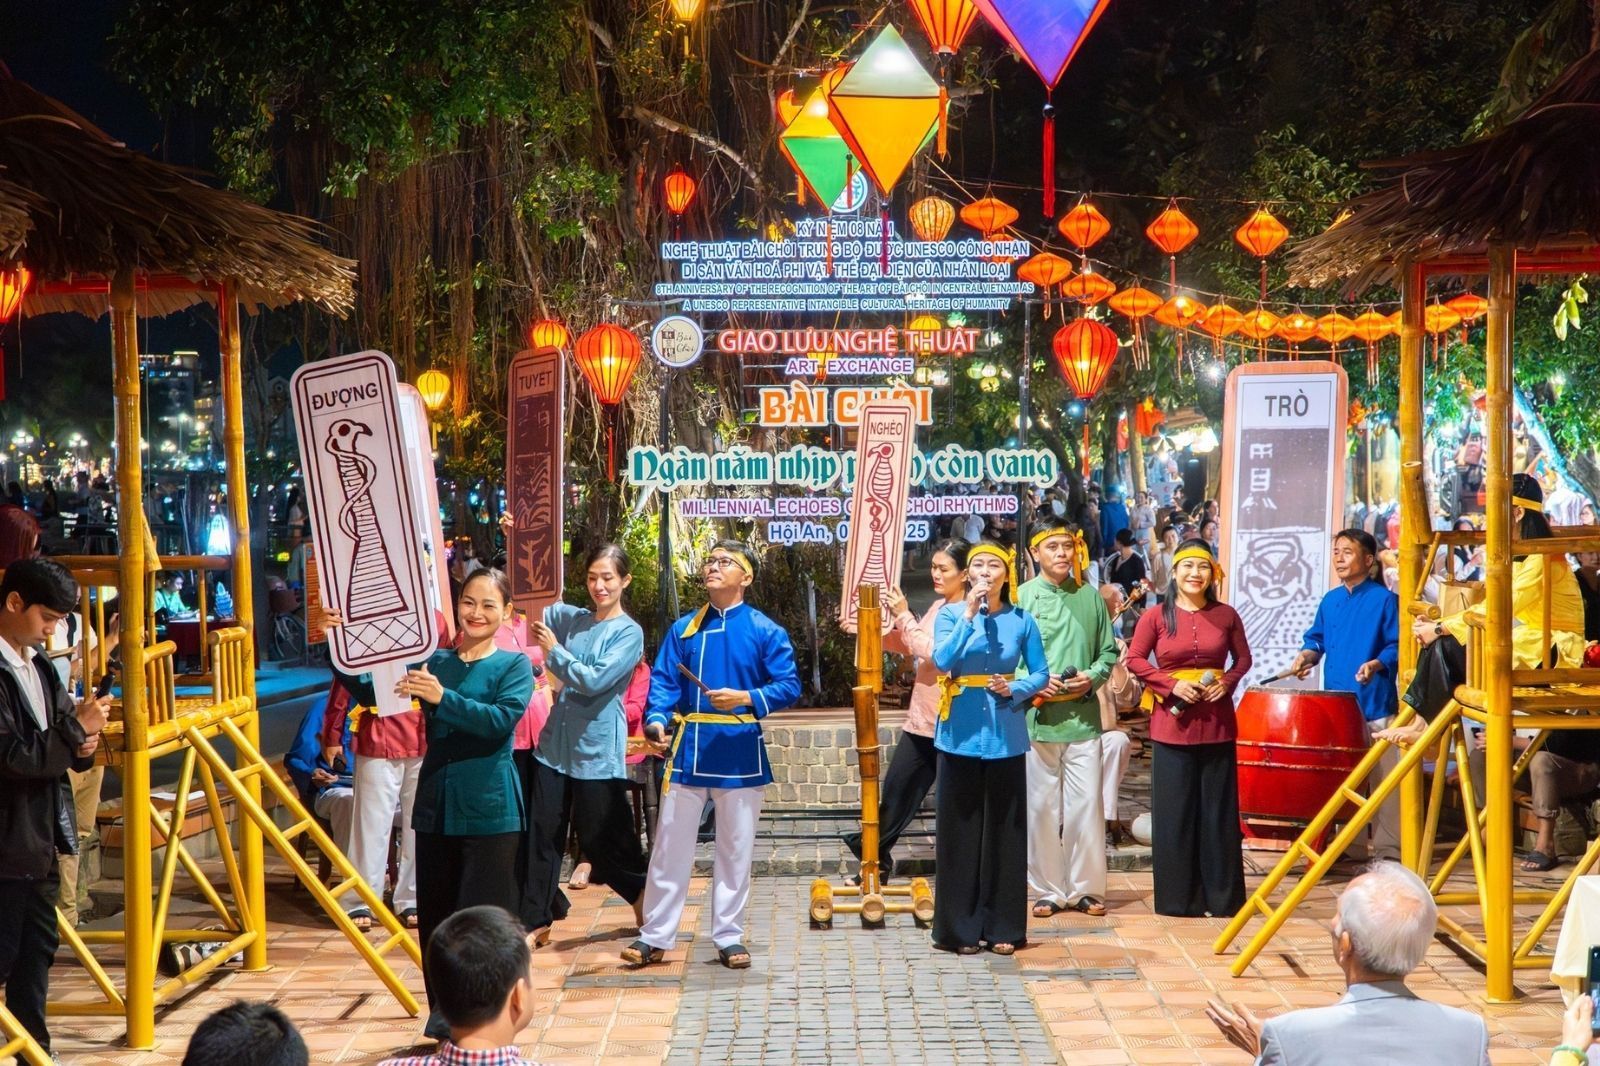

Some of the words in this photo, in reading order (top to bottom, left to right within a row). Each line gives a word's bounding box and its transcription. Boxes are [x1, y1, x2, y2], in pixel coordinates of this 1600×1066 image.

[817, 219, 847, 239] NỆM
[850, 221, 864, 236] 08
[664, 242, 698, 260] NGHỆ
[700, 242, 740, 260] THUẬT
[743, 240, 763, 257] BÀI
[766, 240, 796, 257] CHÒI
[798, 242, 840, 257] TRUNG
[844, 241, 862, 259] BỘ
[905, 241, 956, 257] UNESCO
[957, 239, 993, 256] CÔNG
[994, 239, 1029, 258] NHẬN
[683, 263, 696, 278] DI
[698, 261, 723, 278] SẢN
[726, 261, 752, 278] VĂN
[755, 261, 781, 278] HOÁ
[783, 263, 803, 278] PHI
[806, 261, 829, 279] VẬT
[861, 262, 881, 279] ĐẠI
[884, 261, 913, 279] DIỆN
[916, 260, 941, 277] CỦA
[944, 260, 978, 277] NHÂN
[981, 262, 1010, 280] LOẠI
[656, 283, 673, 294] 8TH
[674, 283, 734, 294] ANNIVERSARY
[736, 283, 749, 294] OF
[751, 283, 767, 294] THE
[768, 283, 827, 294] RECOGNITION
[828, 283, 841, 294] OF
[842, 283, 859, 294] THE
[860, 283, 878, 294] ART
[879, 283, 892, 294] OF
[932, 282, 941, 293] IN
[943, 282, 982, 293] CENTRAL
[983, 282, 1020, 293] VIETNAM
[1022, 282, 1034, 293] AS
[683, 300, 692, 310] A
[693, 300, 729, 310] UNESCO
[732, 299, 805, 310] REPRESENTATIVE
[808, 299, 857, 310] INTANGIBLE
[862, 299, 905, 310] CULTURAL
[907, 299, 950, 310] HERITAGE
[952, 299, 964, 310] OF
[966, 298, 1010, 310] HUMANITY
[719, 330, 777, 352] GIAO
[784, 327, 827, 352] LƯU
[833, 326, 897, 356] NGHỆ
[905, 326, 979, 356] THUẬT
[787, 360, 818, 373] ART
[827, 360, 912, 373] EXCHANGE
[312, 382, 379, 410] ĐƯỢNG
[762, 382, 826, 423] BÀI
[1264, 388, 1309, 417] TRÒ
[633, 450, 706, 487] Ngàn
[715, 450, 768, 480] năm
[780, 448, 837, 486] nhịp
[935, 448, 979, 478] còn
[991, 452, 1054, 484] vang
[682, 500, 772, 515] MILLENNIAL
[777, 499, 840, 515] ECHOES
[944, 497, 1016, 512] RHYTHMS
[771, 524, 800, 543] Hội
[802, 524, 831, 542] An,
